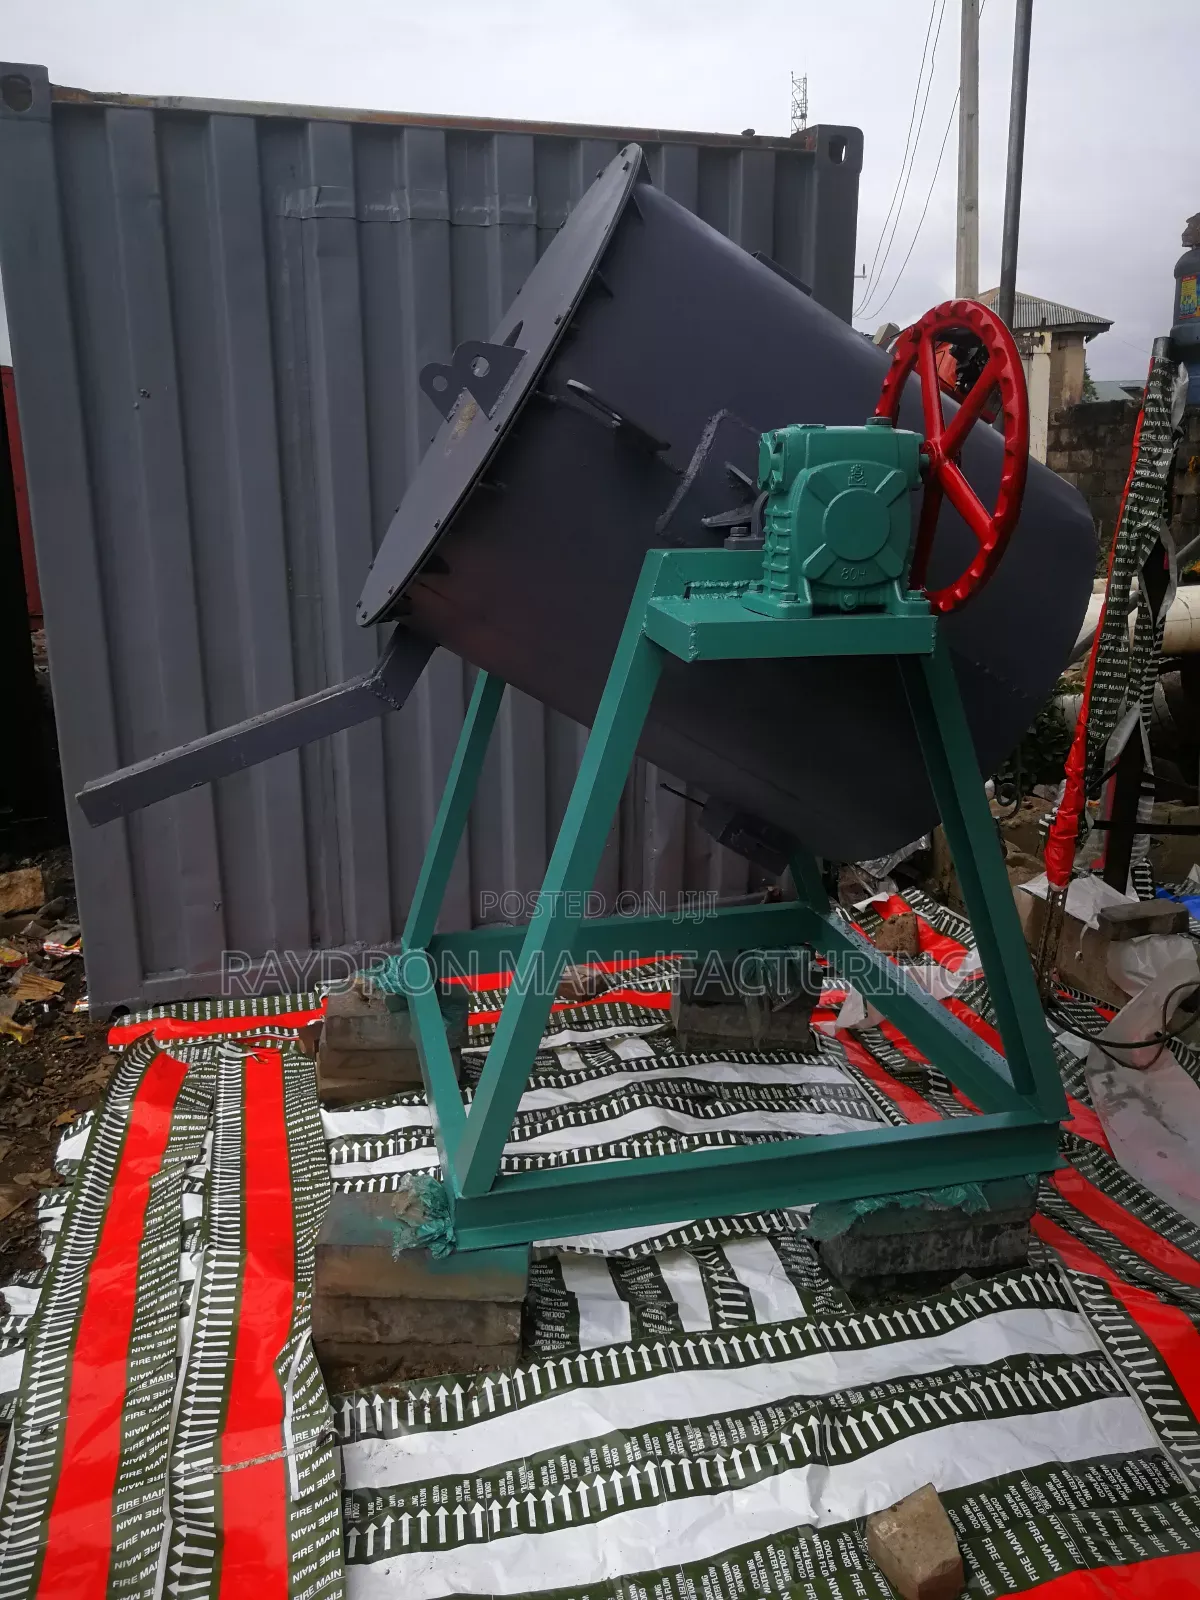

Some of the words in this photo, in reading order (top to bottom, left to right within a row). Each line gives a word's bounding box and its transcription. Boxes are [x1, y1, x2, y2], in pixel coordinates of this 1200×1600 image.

[841, 567, 867, 580] 80H
[197, 1090, 212, 1100] MAIN
[287, 1118, 303, 1127] MAIN
[305, 1113, 319, 1121] FIRE
[141, 1248, 157, 1259] FIRE
[159, 1237, 178, 1250] MAIN
[140, 1269, 157, 1280] FIRE
[159, 1258, 178, 1271] MAIN
[160, 1268, 177, 1279] FIRE
[139, 1279, 159, 1291] MAIN
[158, 1290, 177, 1302] FIRE
[137, 1299, 157, 1313] MAIN
[133, 1333, 152, 1342] FIRE
[154, 1324, 177, 1336] MAIN
[157, 1335, 176, 1346] FIRE
[130, 1357, 151, 1367] FIRE
[153, 1348, 176, 1361] MAIN
[132, 1343, 155, 1353] MAIN
[126, 1395, 150, 1407] MAIN
[153, 1387, 173, 1399] FIRE
[309, 1384, 324, 1406] MAIN
[125, 1410, 146, 1421] FIRE
[149, 1398, 171, 1414] MAIN
[124, 1439, 144, 1454] FIRE
[146, 1423, 170, 1442] MAIN
[149, 1439, 168, 1456] FIRE
[120, 1469, 142, 1480] FIRE
[145, 1453, 167, 1472] MAIN
[122, 1452, 147, 1467] MAIN
[312, 1450, 332, 1470] MAIN
[1127, 1461, 1141, 1479] FLOW
[317, 1470, 335, 1488] FIRE
[1049, 1474, 1061, 1488] FLOW
[1062, 1470, 1077, 1493] WATER
[1088, 1466, 1101, 1484] FLOW
[1100, 1464, 1117, 1488] WATER
[1116, 1487, 1129, 1500] FLOW
[1111, 1469, 1132, 1494] COOLING
[1124, 1467, 1144, 1491] COOLING
[1161, 1461, 1182, 1484] COOLING
[117, 1480, 144, 1494] MAIN
[1008, 1486, 1022, 1501] FLOW
[1021, 1480, 1037, 1503] WATER
[1046, 1482, 1065, 1506] COOLING
[1073, 1476, 1092, 1501] COOLING
[1085, 1473, 1105, 1498] COOLING
[1100, 1483, 1117, 1503] WATER
[1139, 1478, 1156, 1496] WATER
[1154, 1480, 1168, 1495] FLOW
[116, 1498, 139, 1512] FIRE
[291, 1505, 312, 1521] FIRE
[315, 1490, 338, 1509] MAIN
[966, 1497, 978, 1512] FLOW
[991, 1497, 1009, 1520] COOLING
[1004, 1494, 1023, 1518] COOLING
[1061, 1487, 1077, 1511] WATER
[319, 1508, 339, 1527] FIRE
[948, 1509, 966, 1533] COOLING
[962, 1505, 980, 1529] COOLING
[977, 1512, 992, 1533] WATER
[979, 1494, 992, 1512] WATER
[991, 1512, 1006, 1528] FLOW
[1129, 1508, 1151, 1533] MAIN
[1169, 1501, 1193, 1525] MAIN
[116, 1514, 142, 1532] MAIN
[291, 1521, 316, 1541] MAIN
[1047, 1515, 1068, 1540] MAIN
[1088, 1511, 1110, 1537] MAIN
[1109, 1510, 1128, 1533] FIRE
[1125, 1534, 1148, 1556] MAIN
[1149, 1506, 1170, 1526] FIRE
[1167, 1528, 1190, 1550] MAIN
[116, 1534, 138, 1552] FIRE
[292, 1544, 313, 1562] FIRE
[316, 1528, 340, 1548] MAIN
[812, 1534, 824, 1560] WATER
[1004, 1529, 1024, 1556] MAIN
[1025, 1520, 1044, 1543] FIRE
[1040, 1544, 1062, 1572] MAIN
[1068, 1513, 1088, 1533] FIRE
[1083, 1536, 1105, 1562] MAIN
[1148, 1534, 1169, 1553] FIRE
[115, 1552, 141, 1569] MAIN
[320, 1548, 340, 1566] FIRE
[754, 1551, 764, 1568] FLOW
[823, 1540, 837, 1572] COOLING
[837, 1539, 852, 1567] COOLING
[850, 1550, 863, 1570] WATER
[960, 1543, 980, 1569] MAIN
[1064, 1541, 1084, 1564] FIRE
[1106, 1539, 1126, 1561] FIRE
[293, 1561, 317, 1584] MAIN
[767, 1544, 778, 1569] WATER
[774, 1570, 785, 1590] FLOW
[777, 1550, 792, 1581] COOLING
[792, 1546, 806, 1578] COOLING
[982, 1538, 1000, 1560] FIRE
[996, 1562, 1017, 1588] MAIN
[1020, 1556, 1040, 1581] FIRE
[113, 1575, 138, 1587] FIRE
[317, 1569, 342, 1589] MAIN
[722, 1561, 733, 1583] WATER
[729, 1583, 738, 1600] FLOW
[732, 1565, 745, 1592] COOLING
[747, 1559, 760, 1589] COOLING
[760, 1568, 771, 1594] WATER
[850, 1574, 866, 1596] FIRE
[872, 1572, 890, 1597] MAIN
[975, 1570, 995, 1596] FIRE
